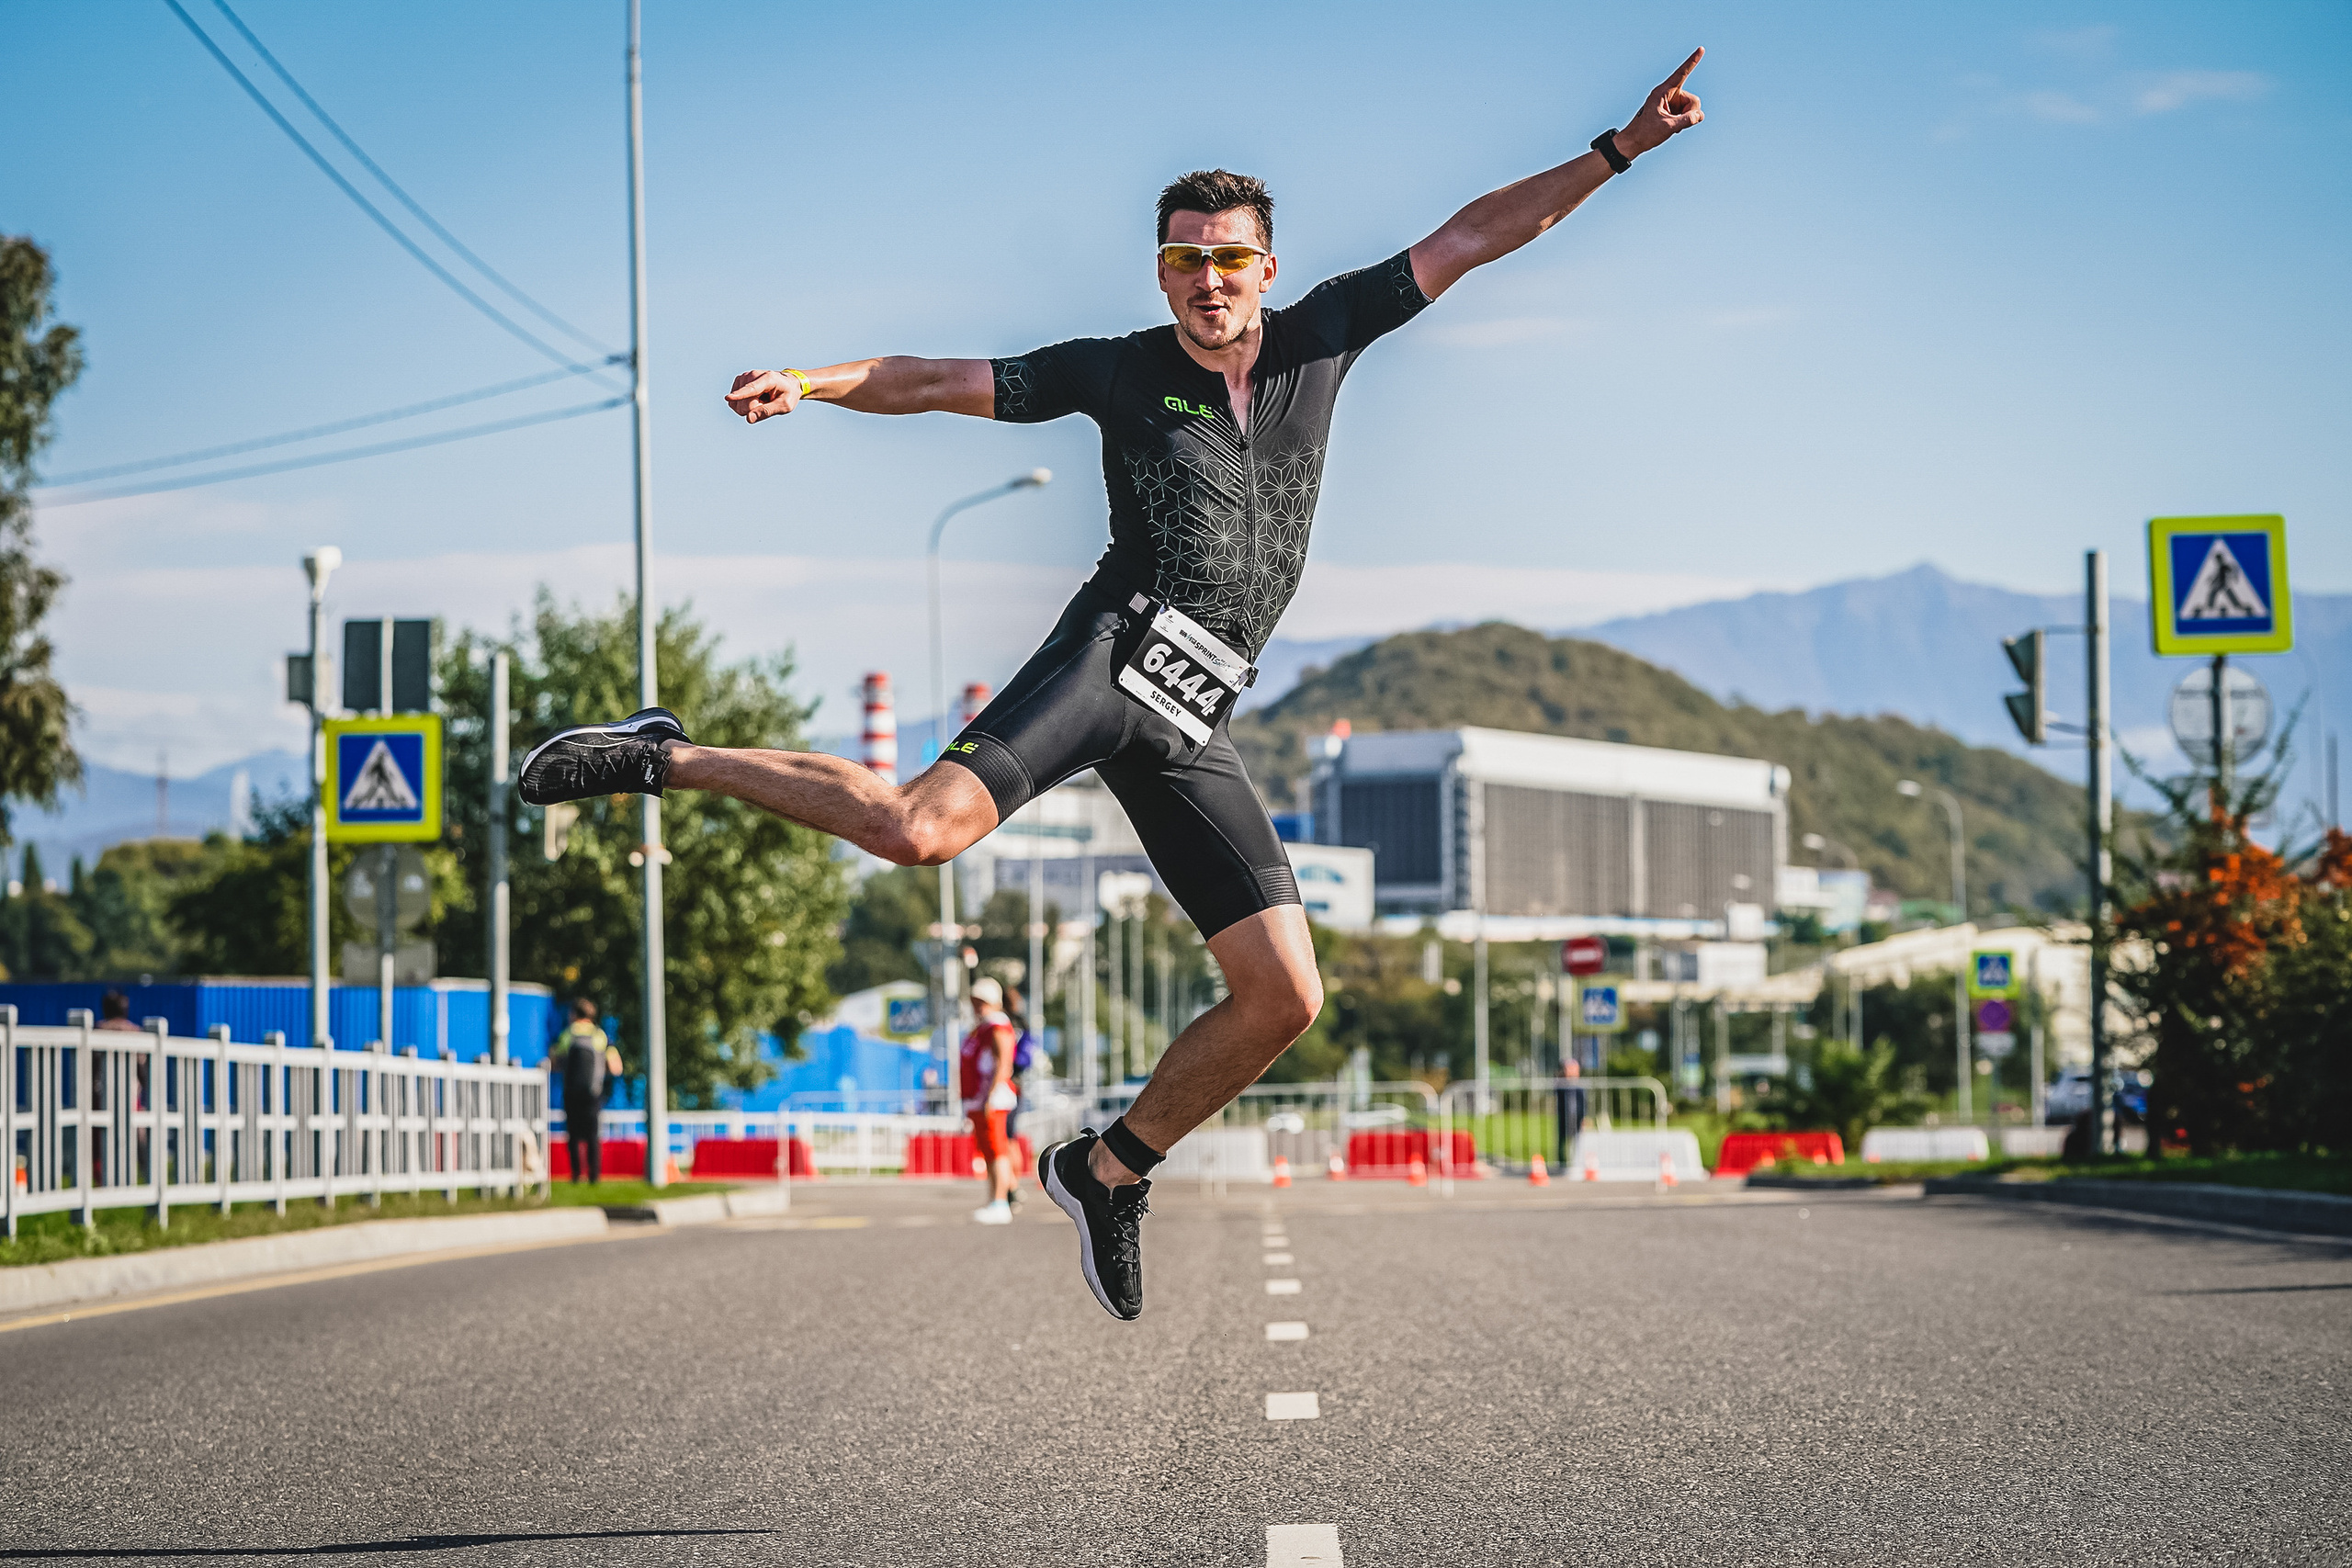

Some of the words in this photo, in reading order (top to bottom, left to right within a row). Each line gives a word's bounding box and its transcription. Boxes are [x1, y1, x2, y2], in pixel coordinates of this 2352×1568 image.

[1194, 643, 1217, 661] SPRINT
[1143, 643, 1225, 716] 6444
[1150, 690, 1182, 716] SERGEY
